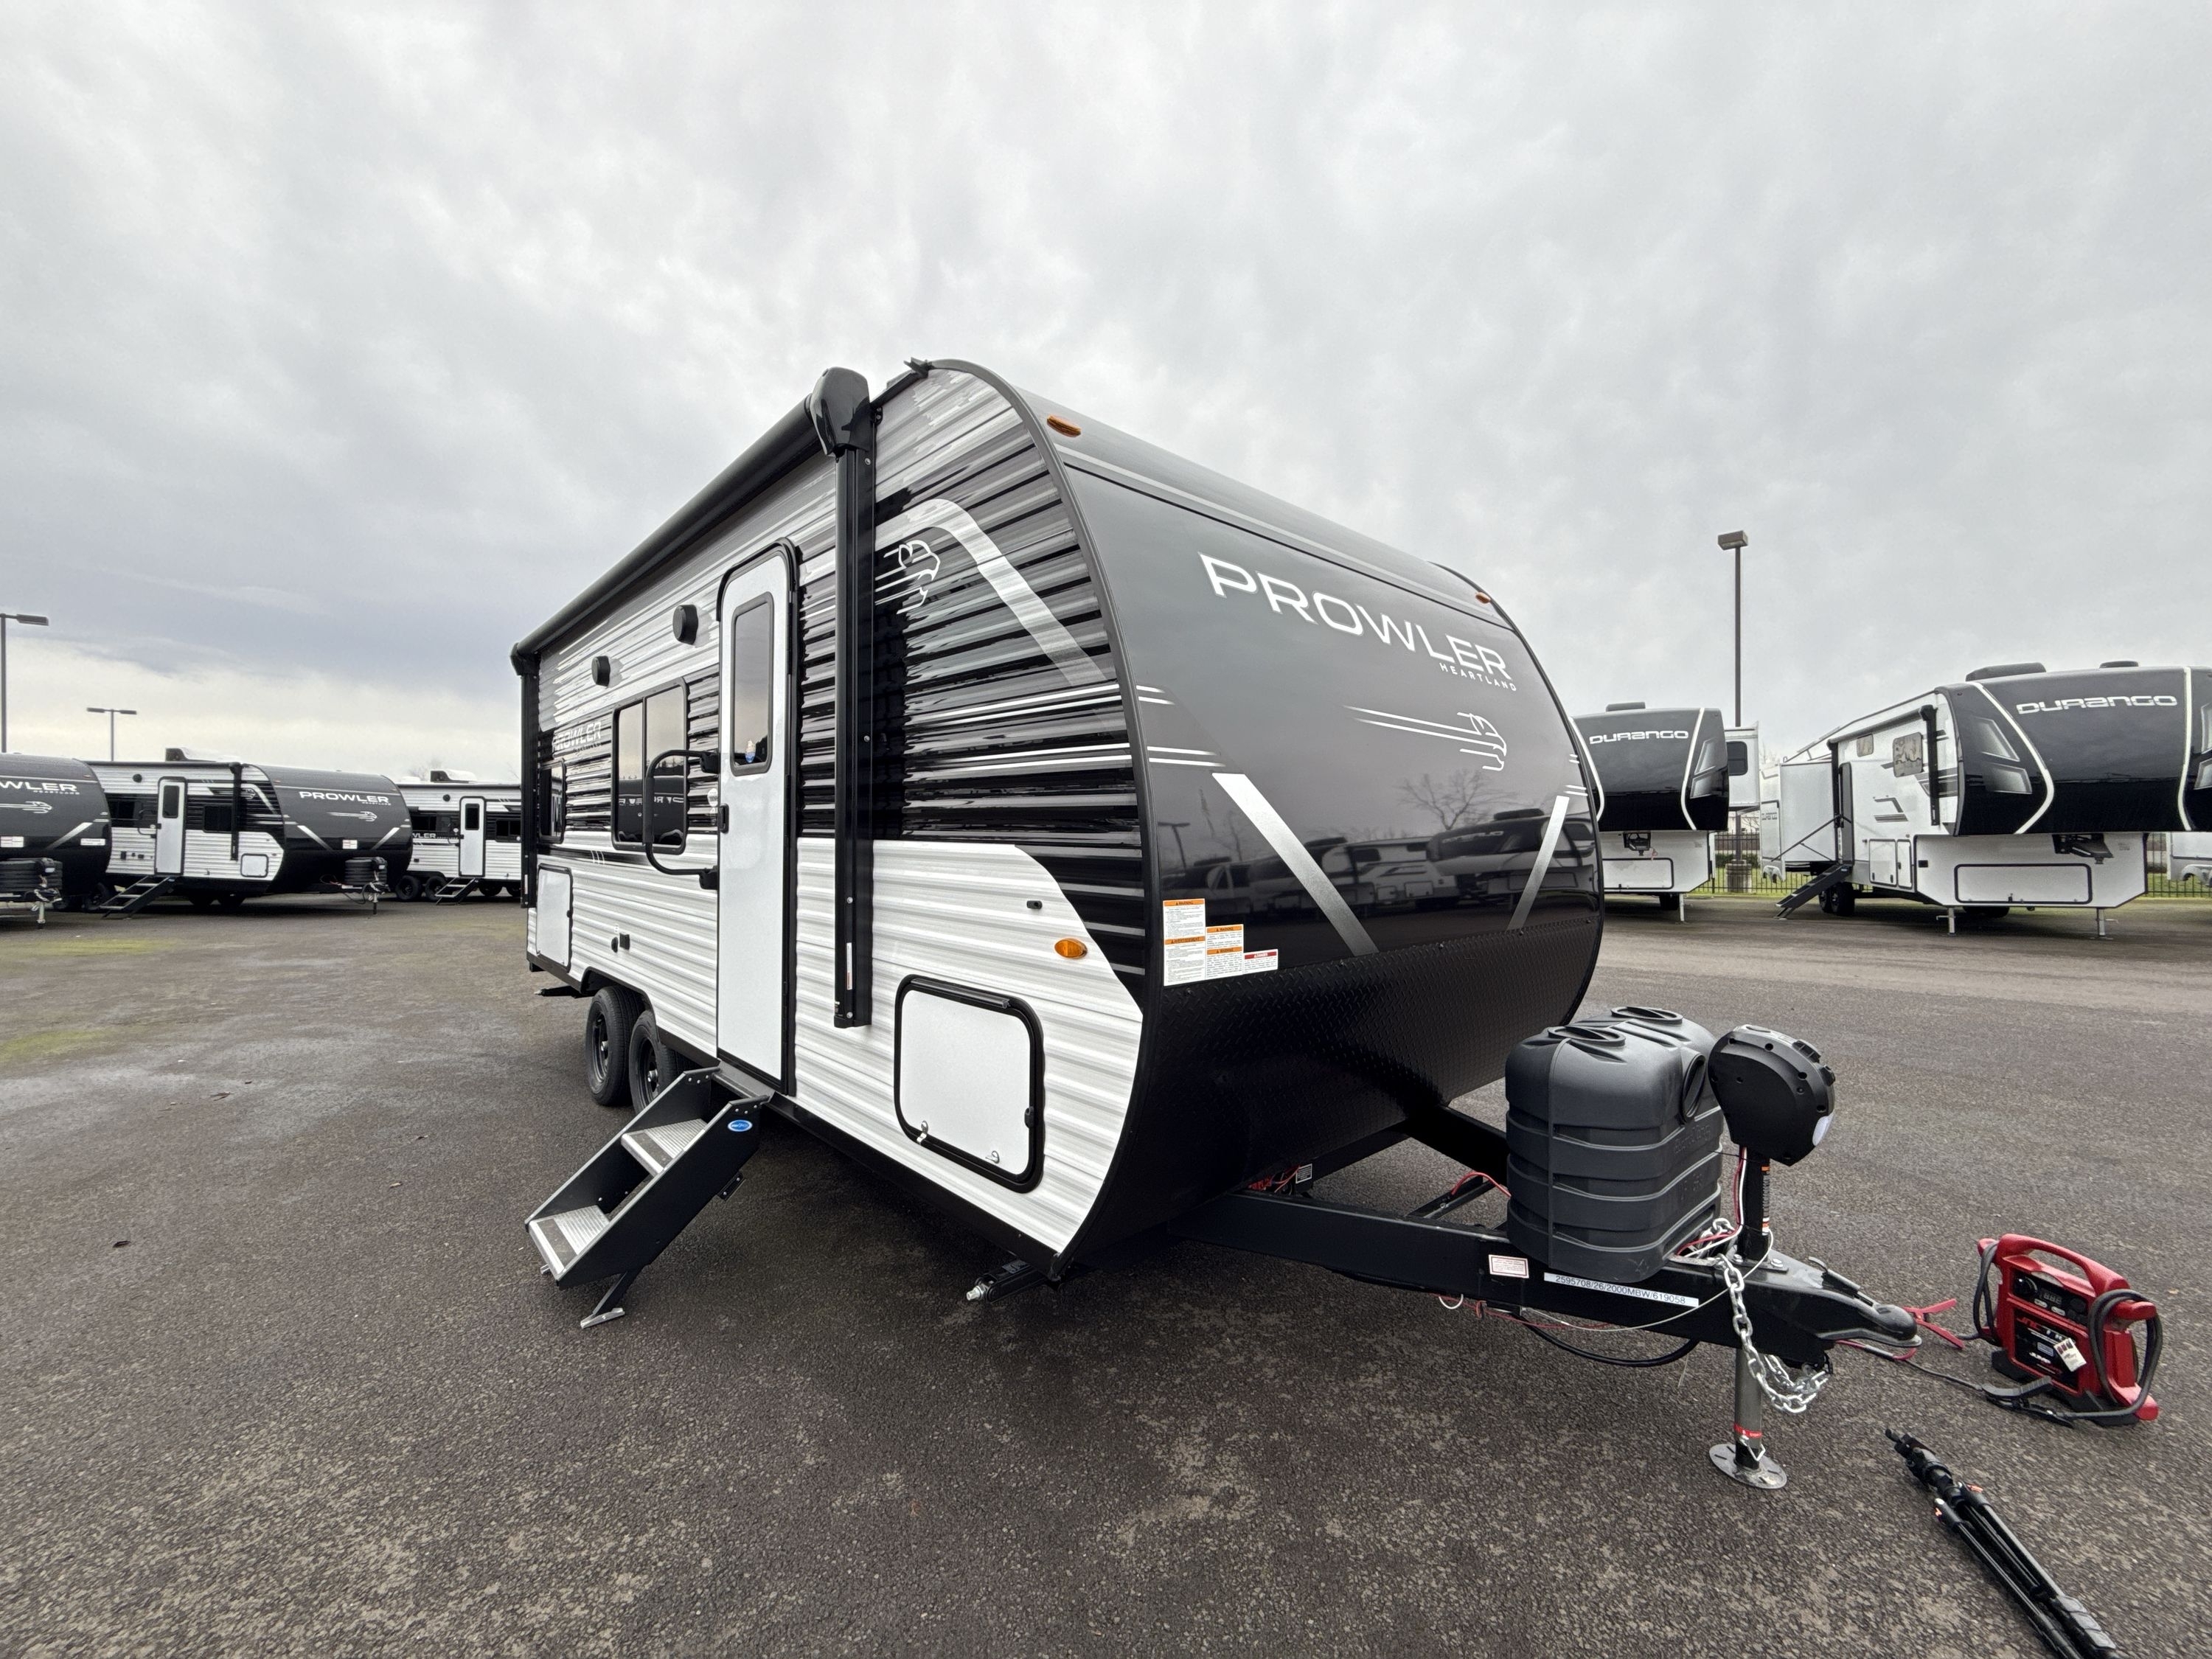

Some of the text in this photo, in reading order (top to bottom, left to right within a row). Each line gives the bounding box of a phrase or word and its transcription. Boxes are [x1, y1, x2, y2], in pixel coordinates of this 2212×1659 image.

[1197, 552, 1512, 681] PROWLER
[1439, 662, 1517, 692] HEARTLAND
[2016, 695, 2178, 714] DURANGO
[1589, 730, 1689, 745] DURANGO
[299, 791, 389, 804] PROWLER
[1555, 1275, 1686, 1305] 2595708/26/2000MBW/619058
